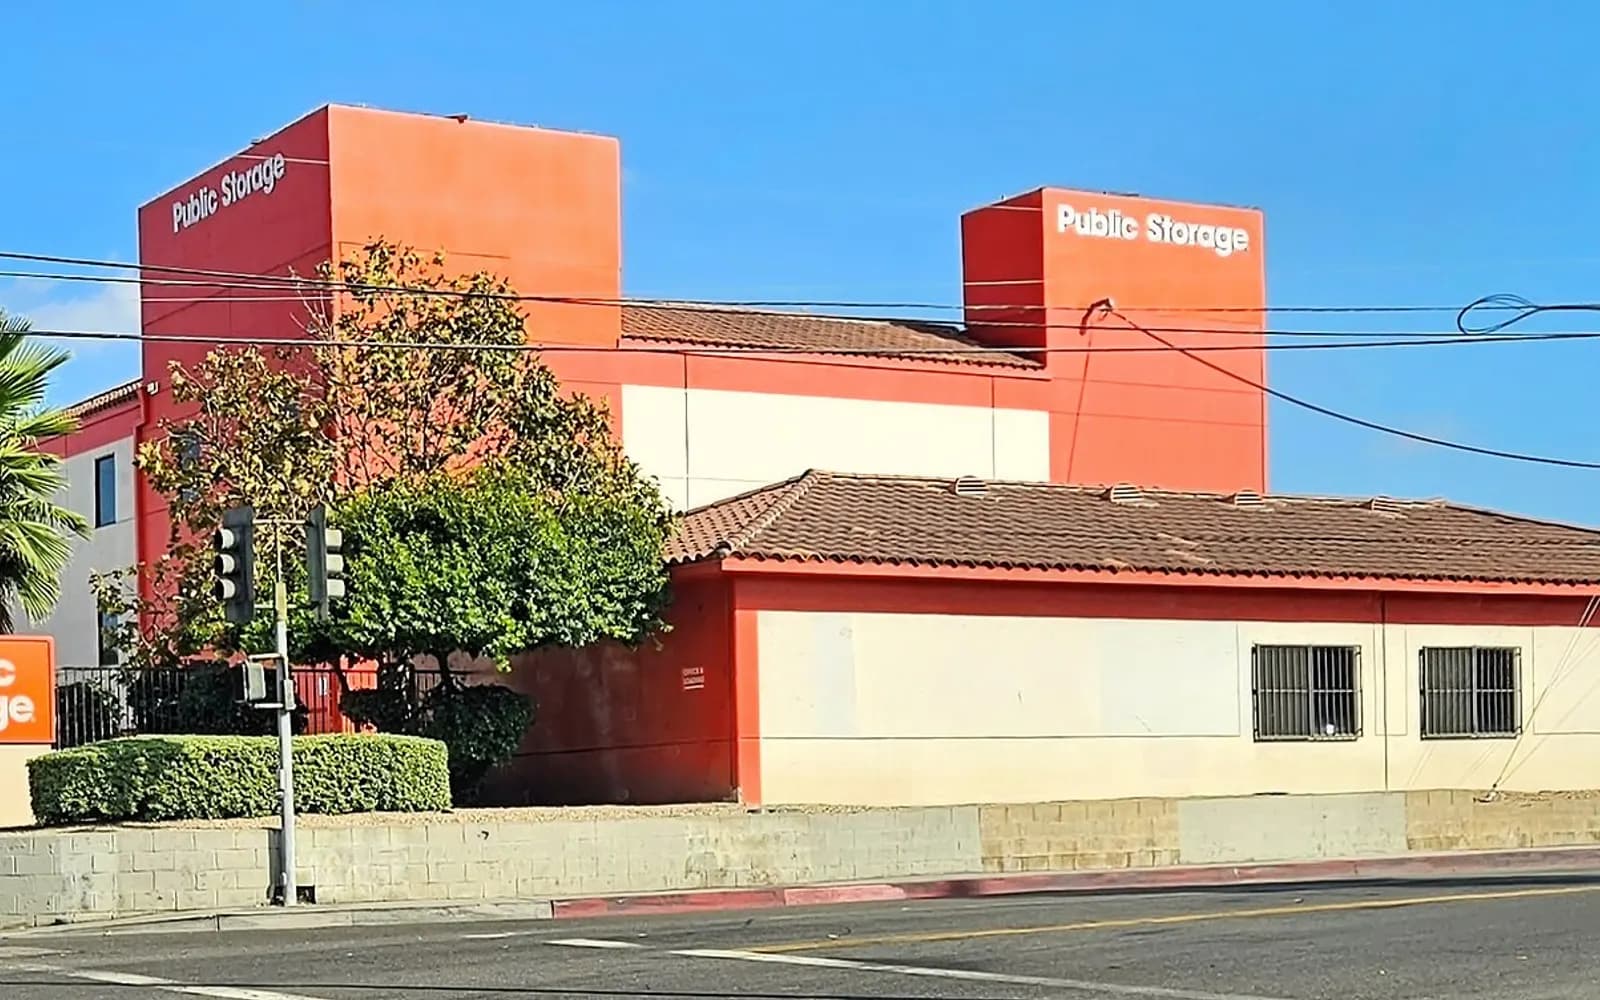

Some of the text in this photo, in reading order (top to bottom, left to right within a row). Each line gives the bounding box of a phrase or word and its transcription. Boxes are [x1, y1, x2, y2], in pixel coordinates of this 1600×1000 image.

[172, 153, 285, 232] Public Storage
[1057, 203, 1249, 257] Public Storage
